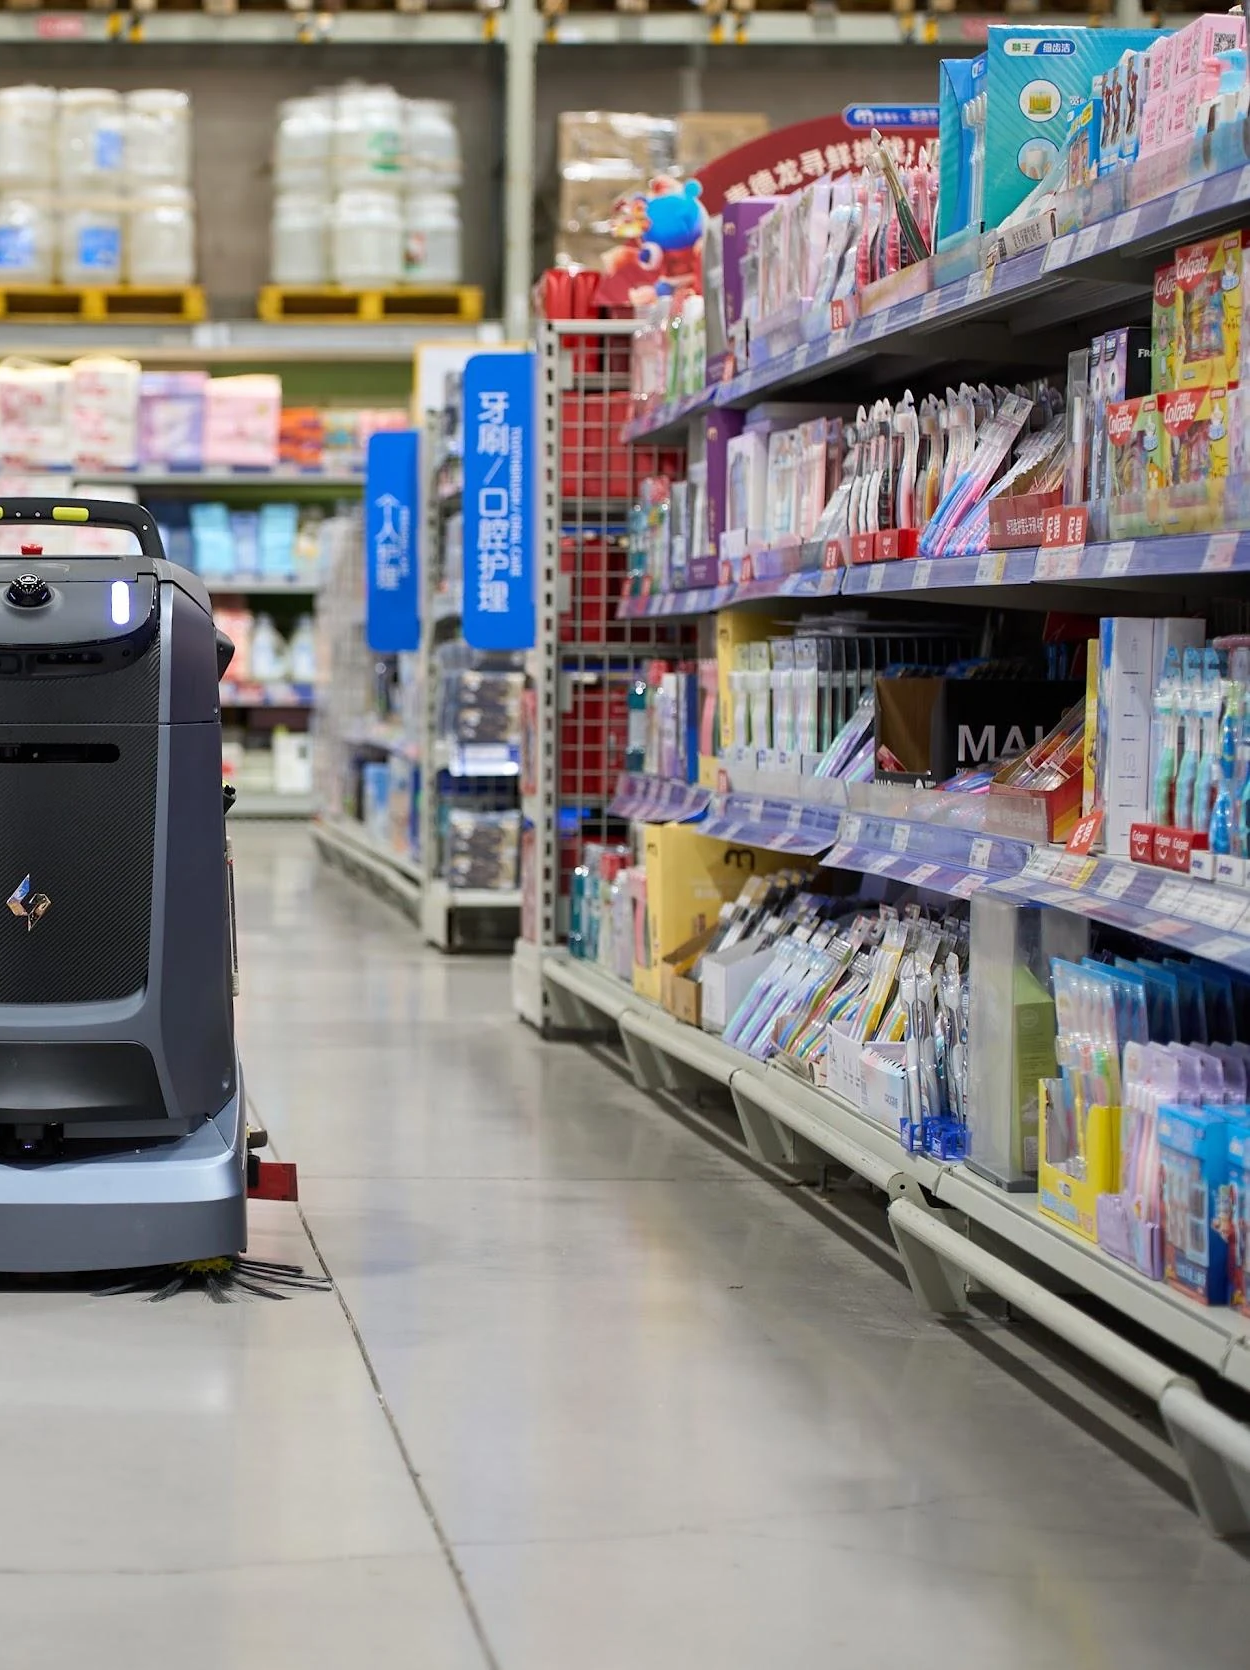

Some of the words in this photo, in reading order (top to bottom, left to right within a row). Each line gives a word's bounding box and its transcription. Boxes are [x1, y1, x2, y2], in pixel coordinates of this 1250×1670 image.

[1176, 255, 1209, 283] Colgate
[1155, 272, 1177, 299] Colga
[1108, 413, 1133, 439] Colgate
[1164, 402, 1196, 428] Colgate
